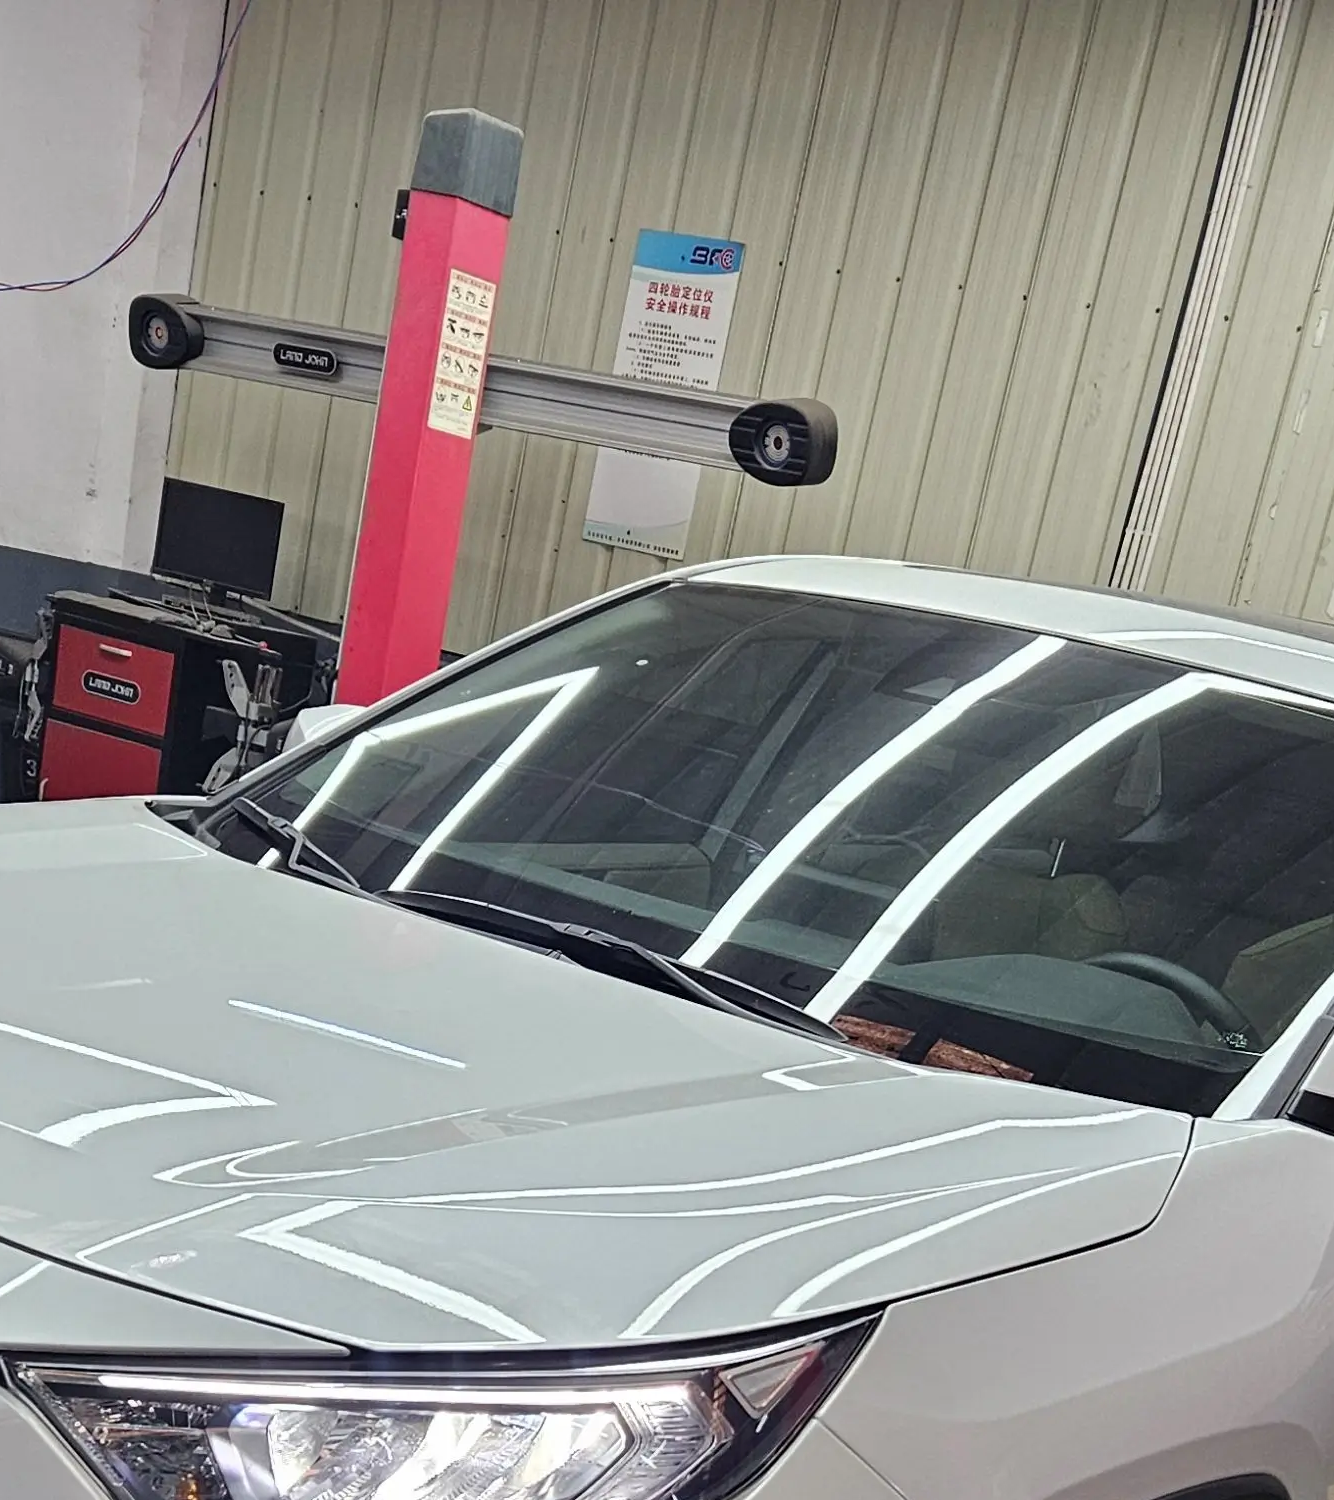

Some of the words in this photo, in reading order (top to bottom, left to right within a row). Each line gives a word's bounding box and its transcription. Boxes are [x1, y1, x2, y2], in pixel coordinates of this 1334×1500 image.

[648, 281, 714, 304] 四轮胎定位仪
[645, 297, 712, 320] 安全操作规程
[304, 354, 328, 367] JOHN
